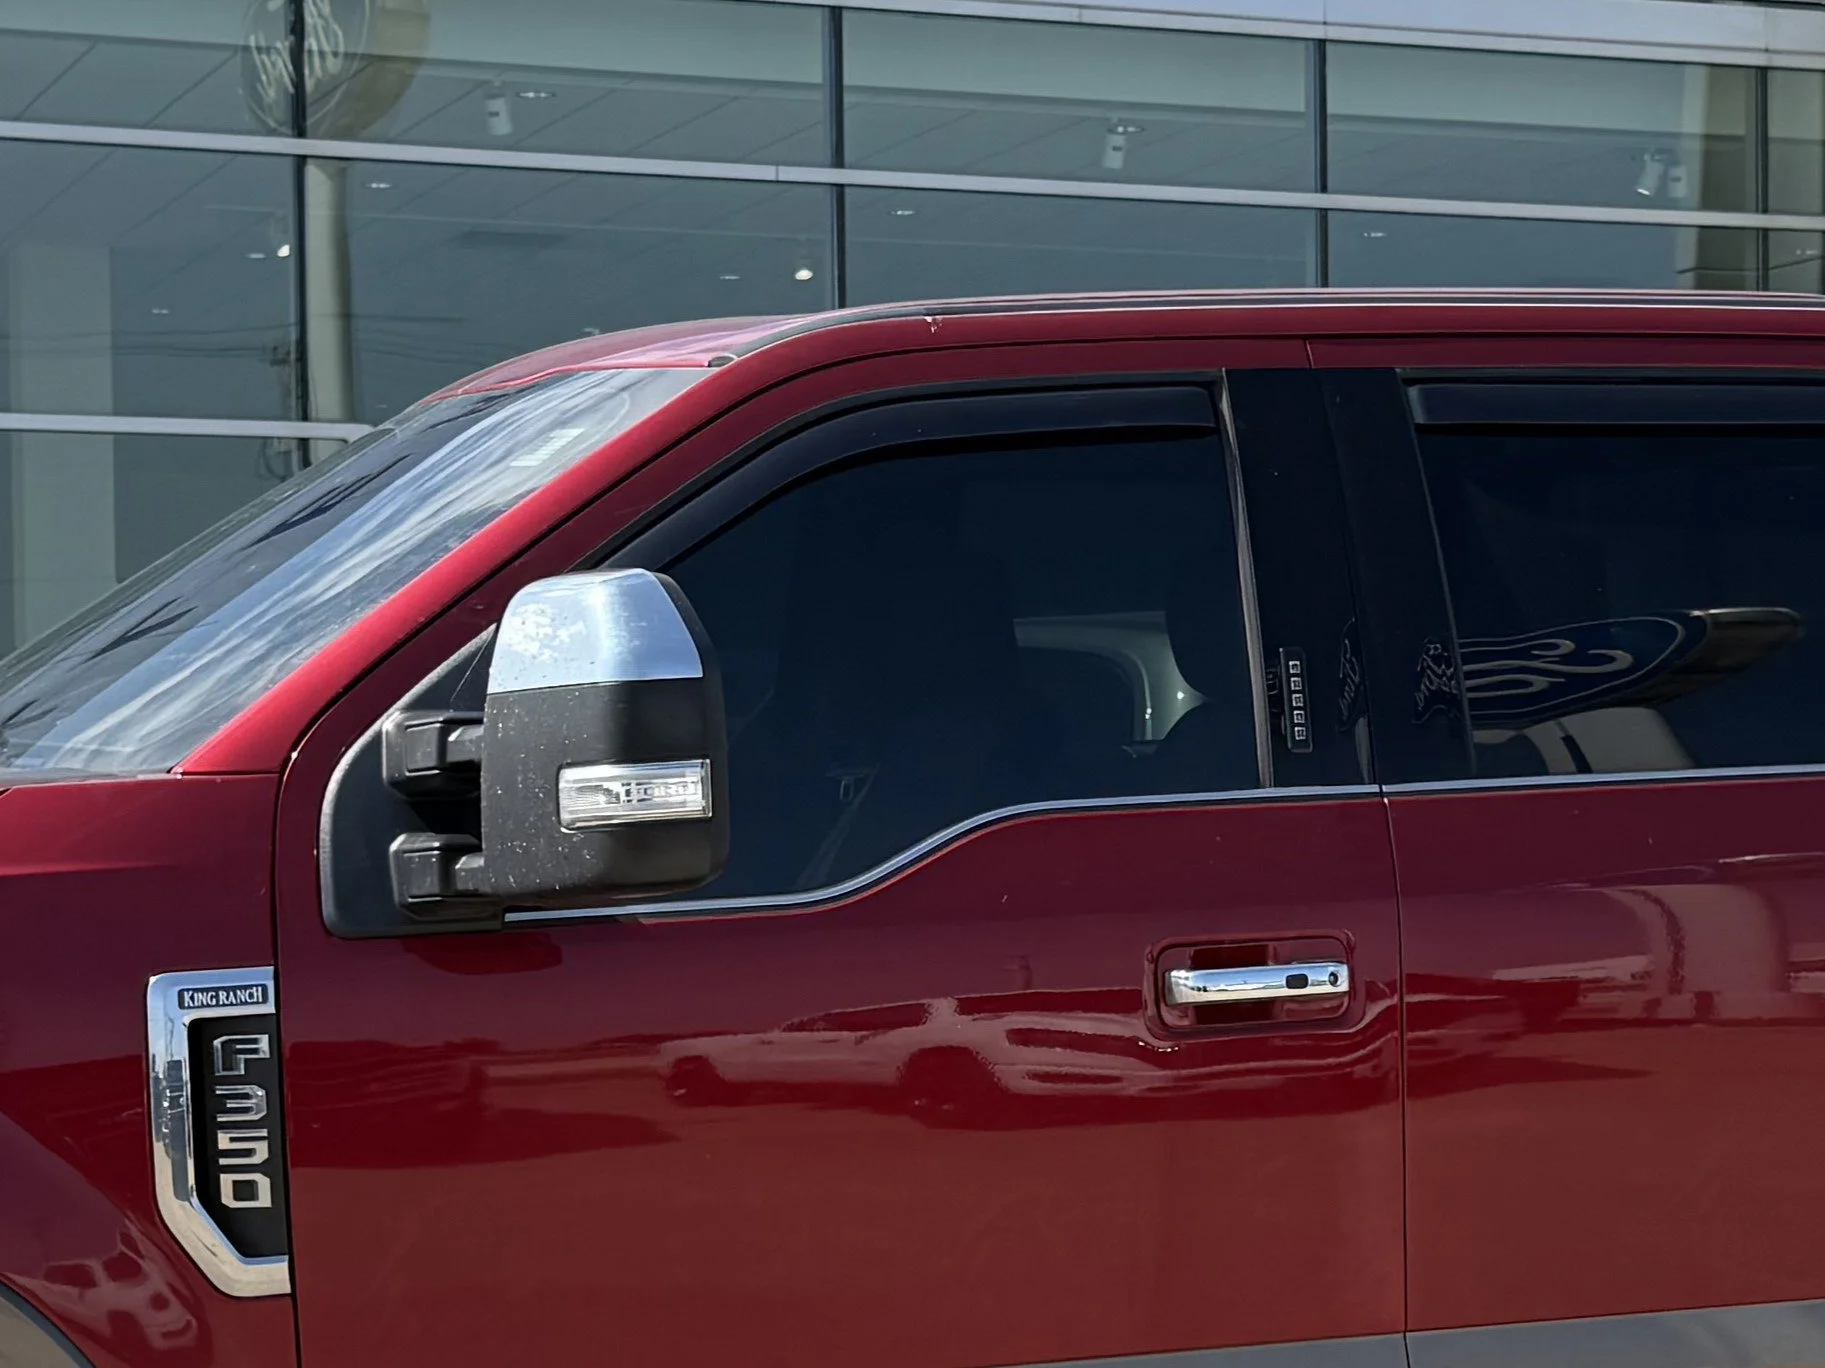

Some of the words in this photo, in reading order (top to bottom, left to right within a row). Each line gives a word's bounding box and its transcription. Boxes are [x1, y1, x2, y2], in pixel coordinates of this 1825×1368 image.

[184, 990, 216, 1007] KING
[219, 986, 263, 1005] RANCH
[213, 1034, 272, 1209] F350
